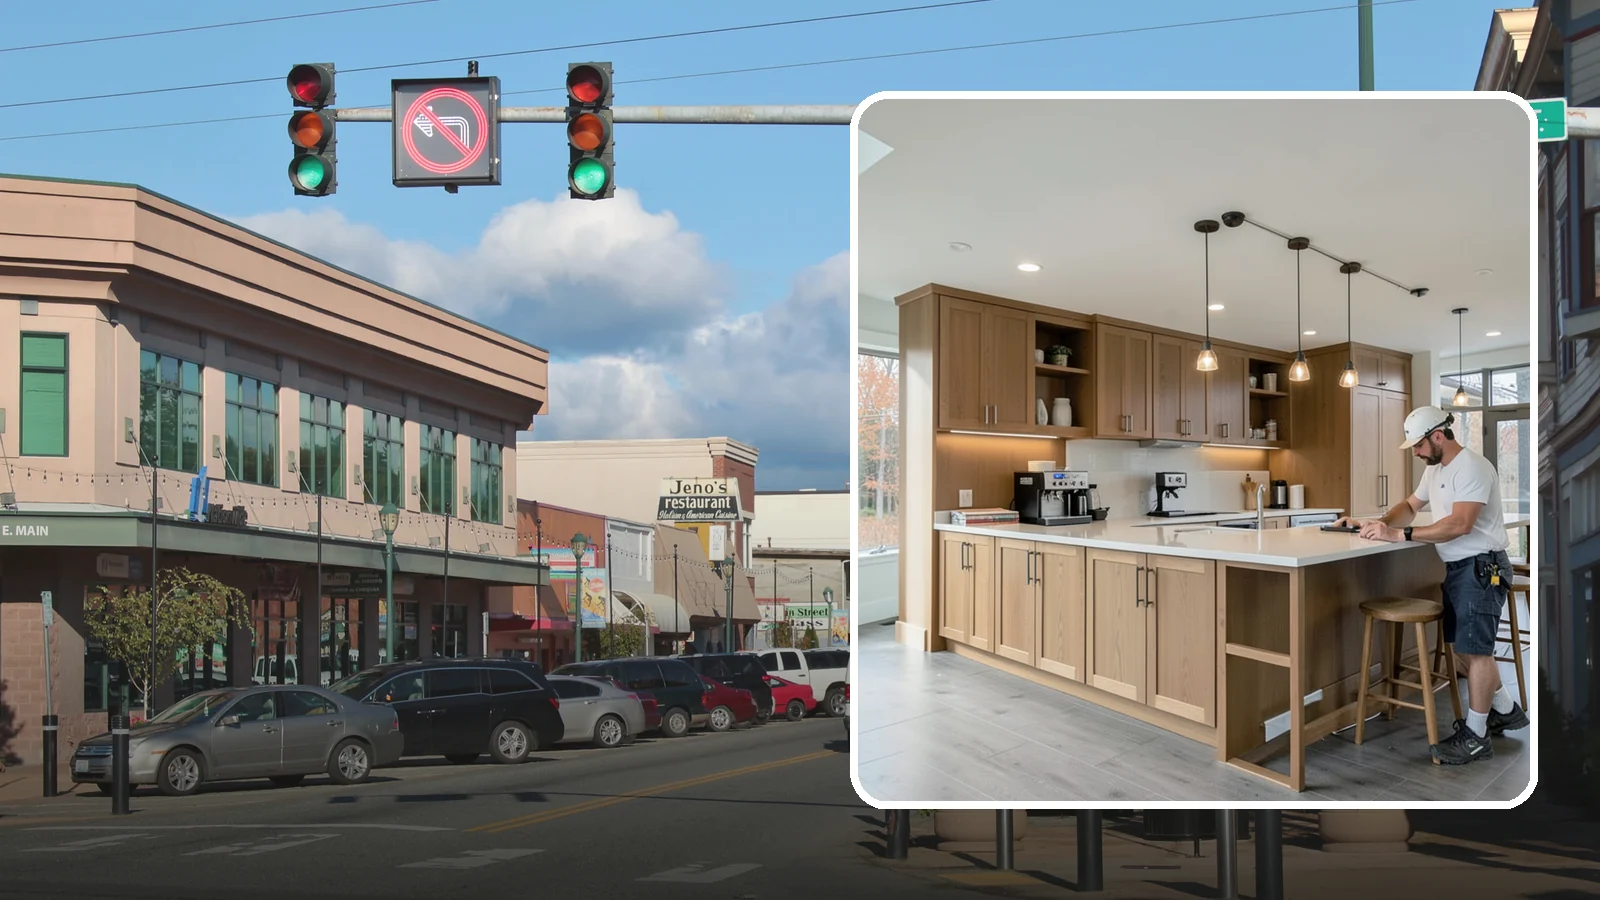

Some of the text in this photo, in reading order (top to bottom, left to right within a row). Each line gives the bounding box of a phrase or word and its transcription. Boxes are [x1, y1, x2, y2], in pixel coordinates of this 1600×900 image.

[669, 480, 727, 494] Jeno's
[665, 496, 731, 509] restaurant
[659, 510, 681, 519] Italian
[686, 509, 714, 519] American
[715, 509, 737, 519] Cuisine
[2, 525, 49, 536] E. MAIN
[797, 607, 828, 617] Street
[790, 619, 823, 627] lass
